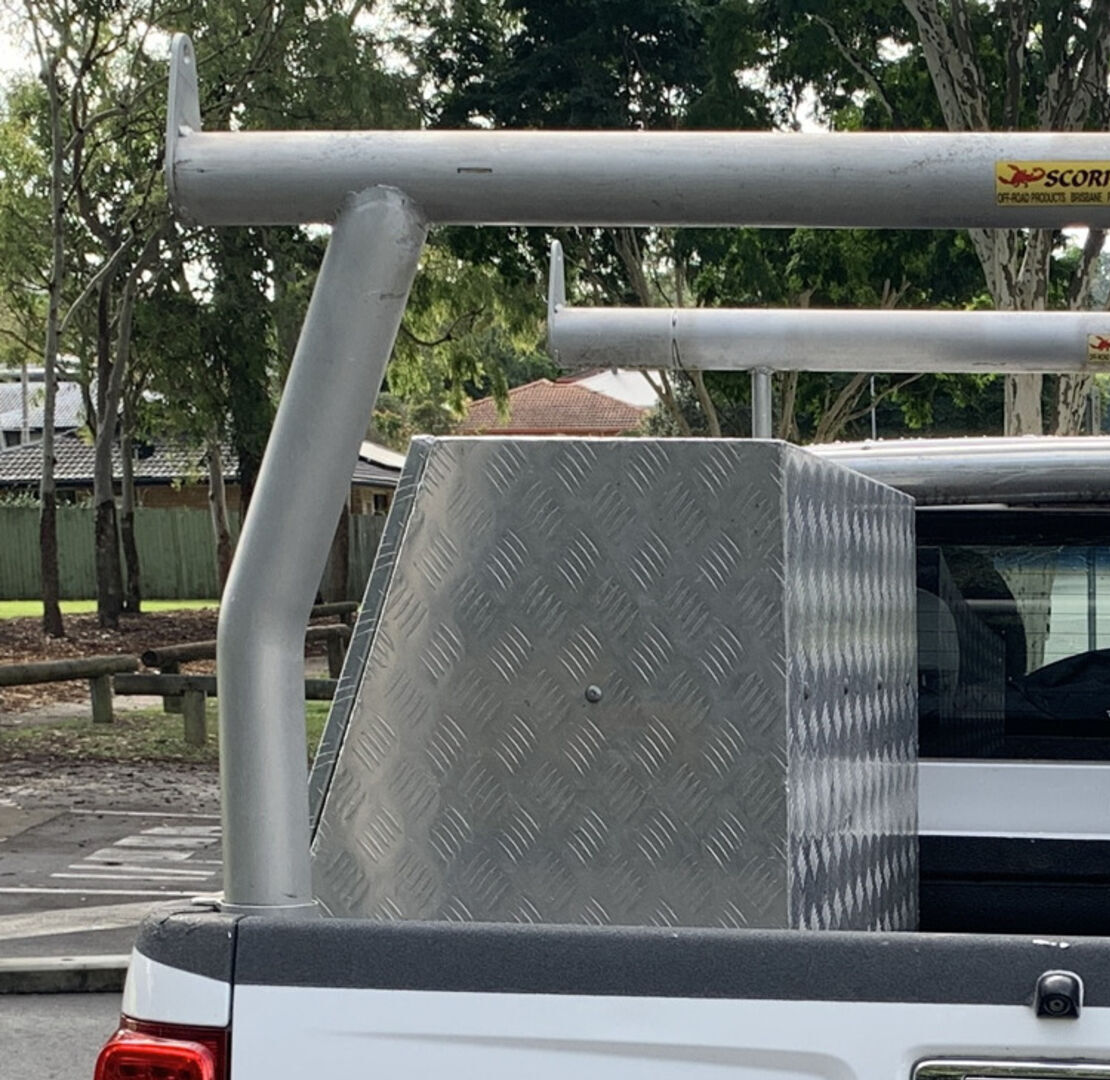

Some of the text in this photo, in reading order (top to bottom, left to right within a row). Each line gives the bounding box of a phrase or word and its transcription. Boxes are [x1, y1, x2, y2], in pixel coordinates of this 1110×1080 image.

[998, 191, 1030, 203] OFF-ROAD
[1031, 191, 1066, 203] PRODUCTS
[1070, 191, 1102, 203] BRISBANE
